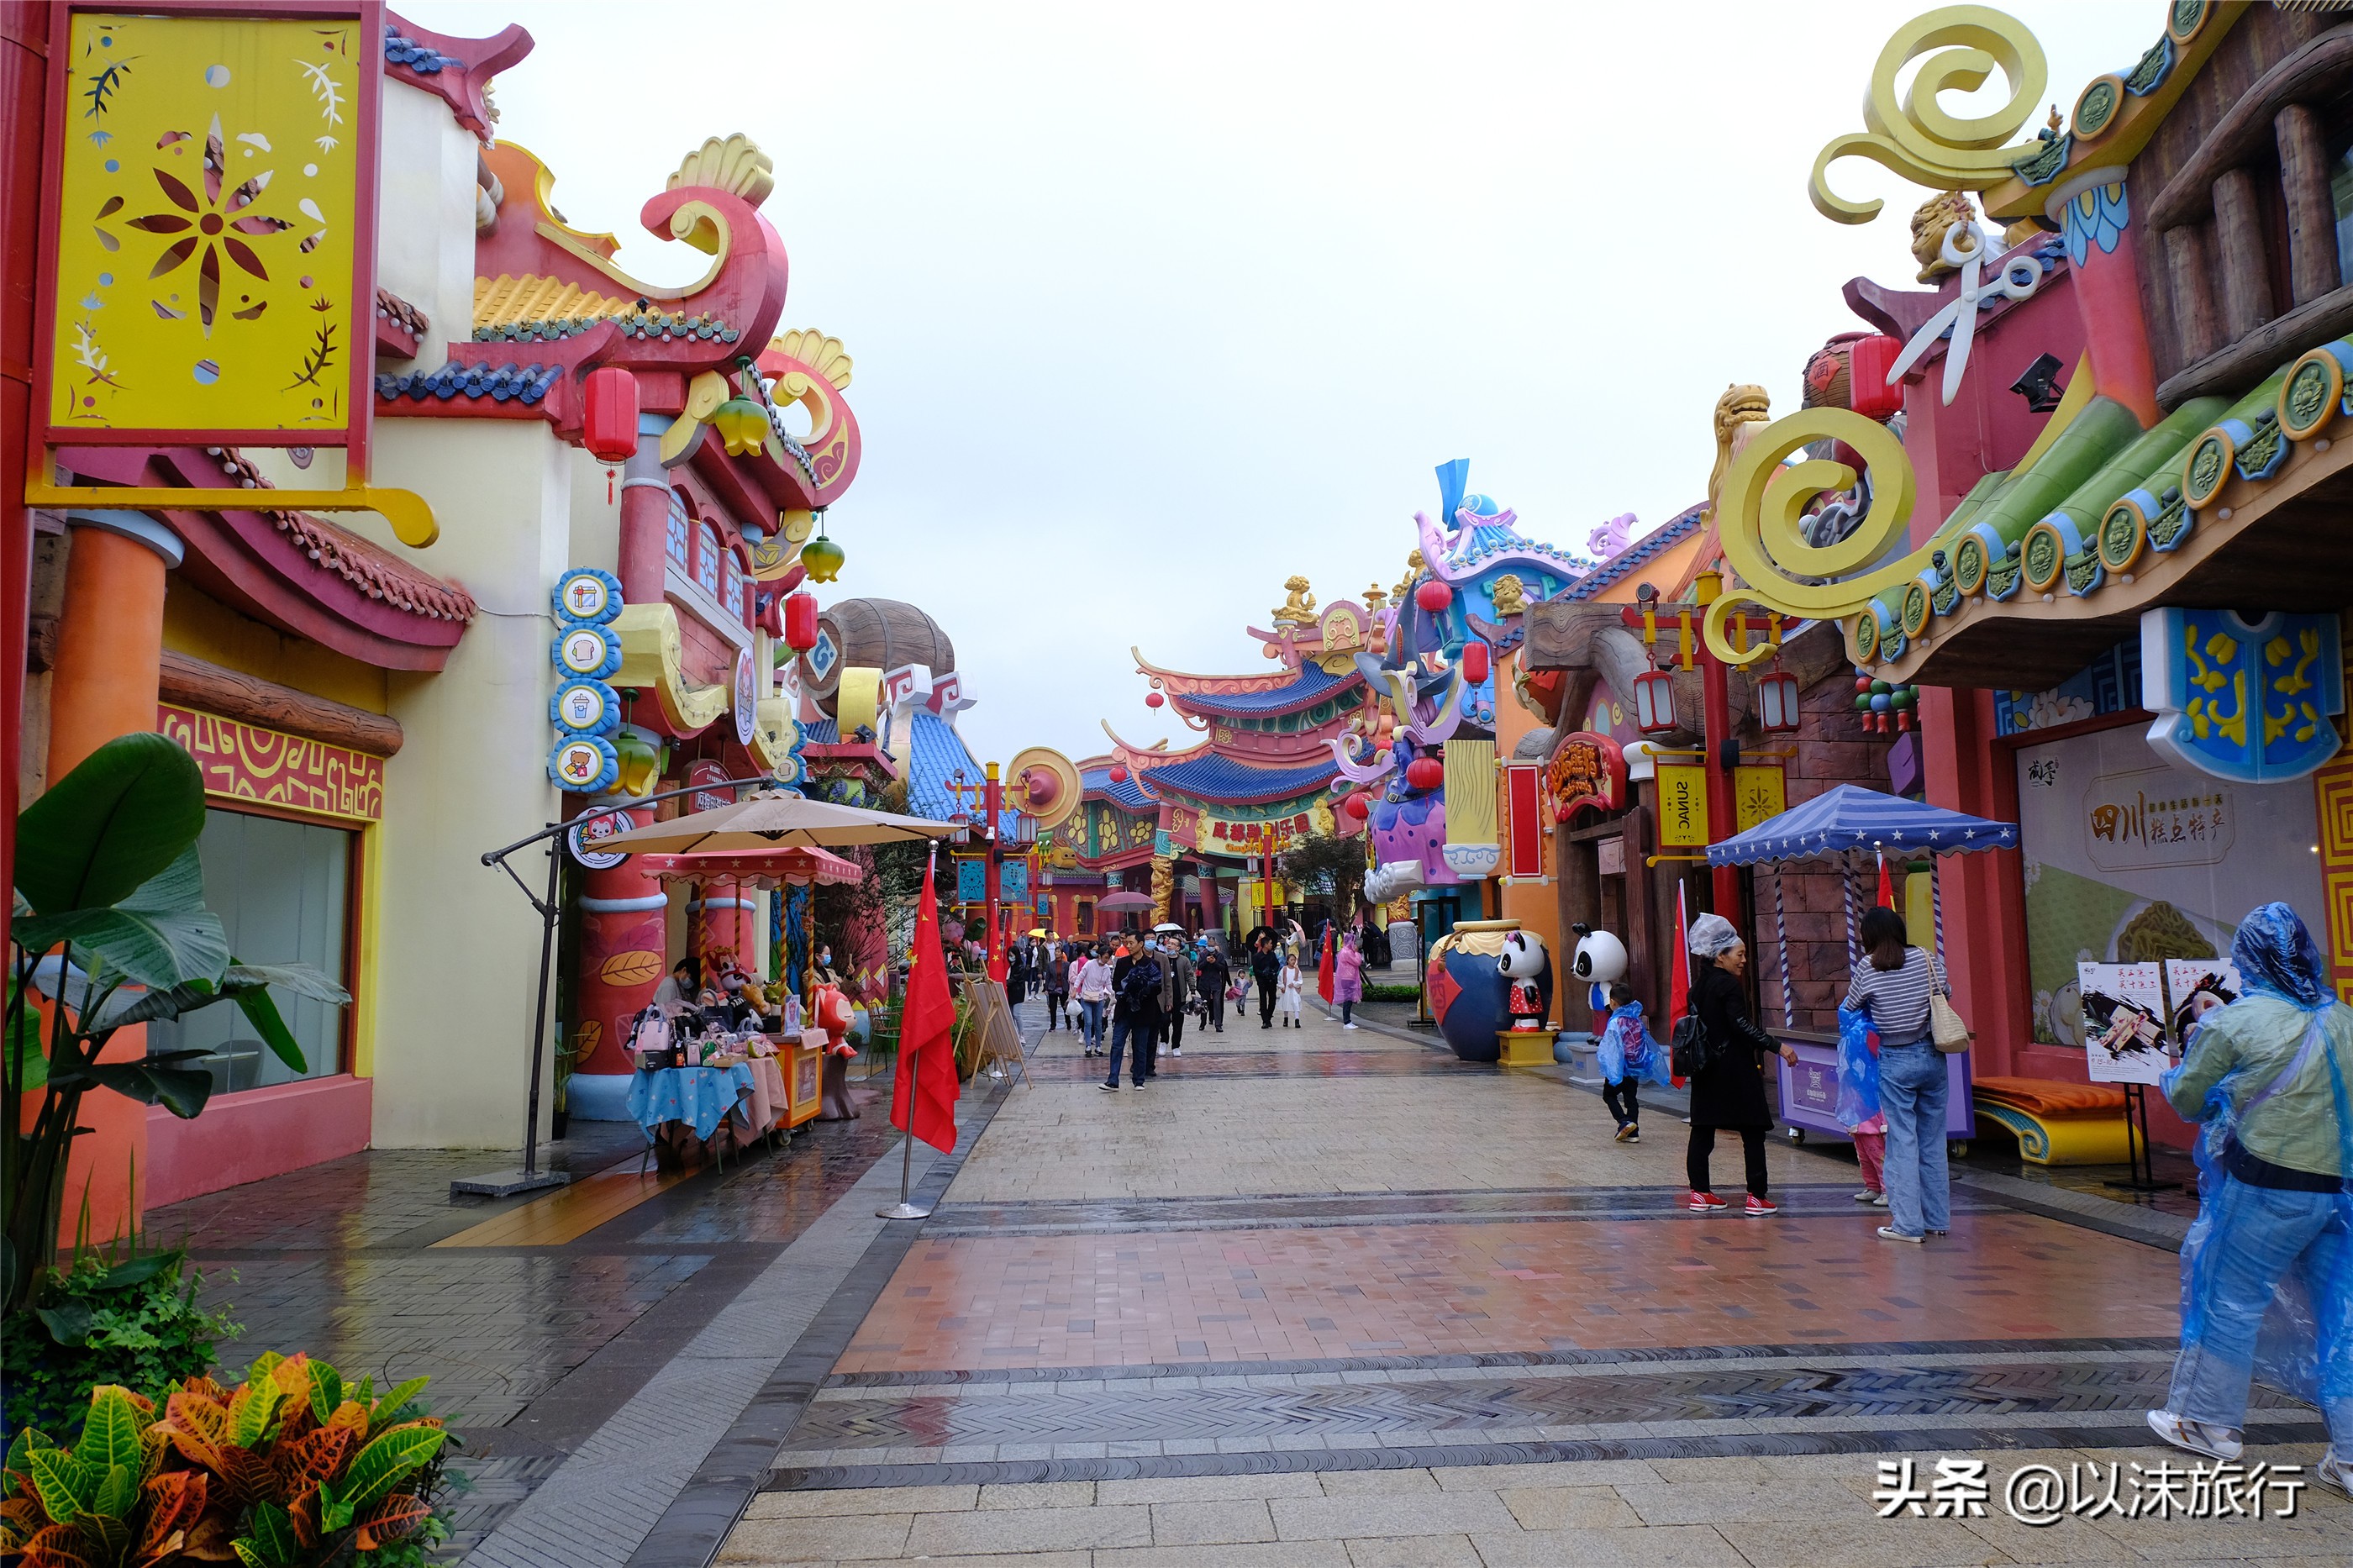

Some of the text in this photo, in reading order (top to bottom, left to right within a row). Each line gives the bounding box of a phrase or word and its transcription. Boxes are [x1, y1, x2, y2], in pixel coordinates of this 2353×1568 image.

[1813, 360, 1829, 381] 酒
[1551, 744, 1598, 793] 巴布熊猫
[2090, 790, 2225, 850] 四川 糕点特产
